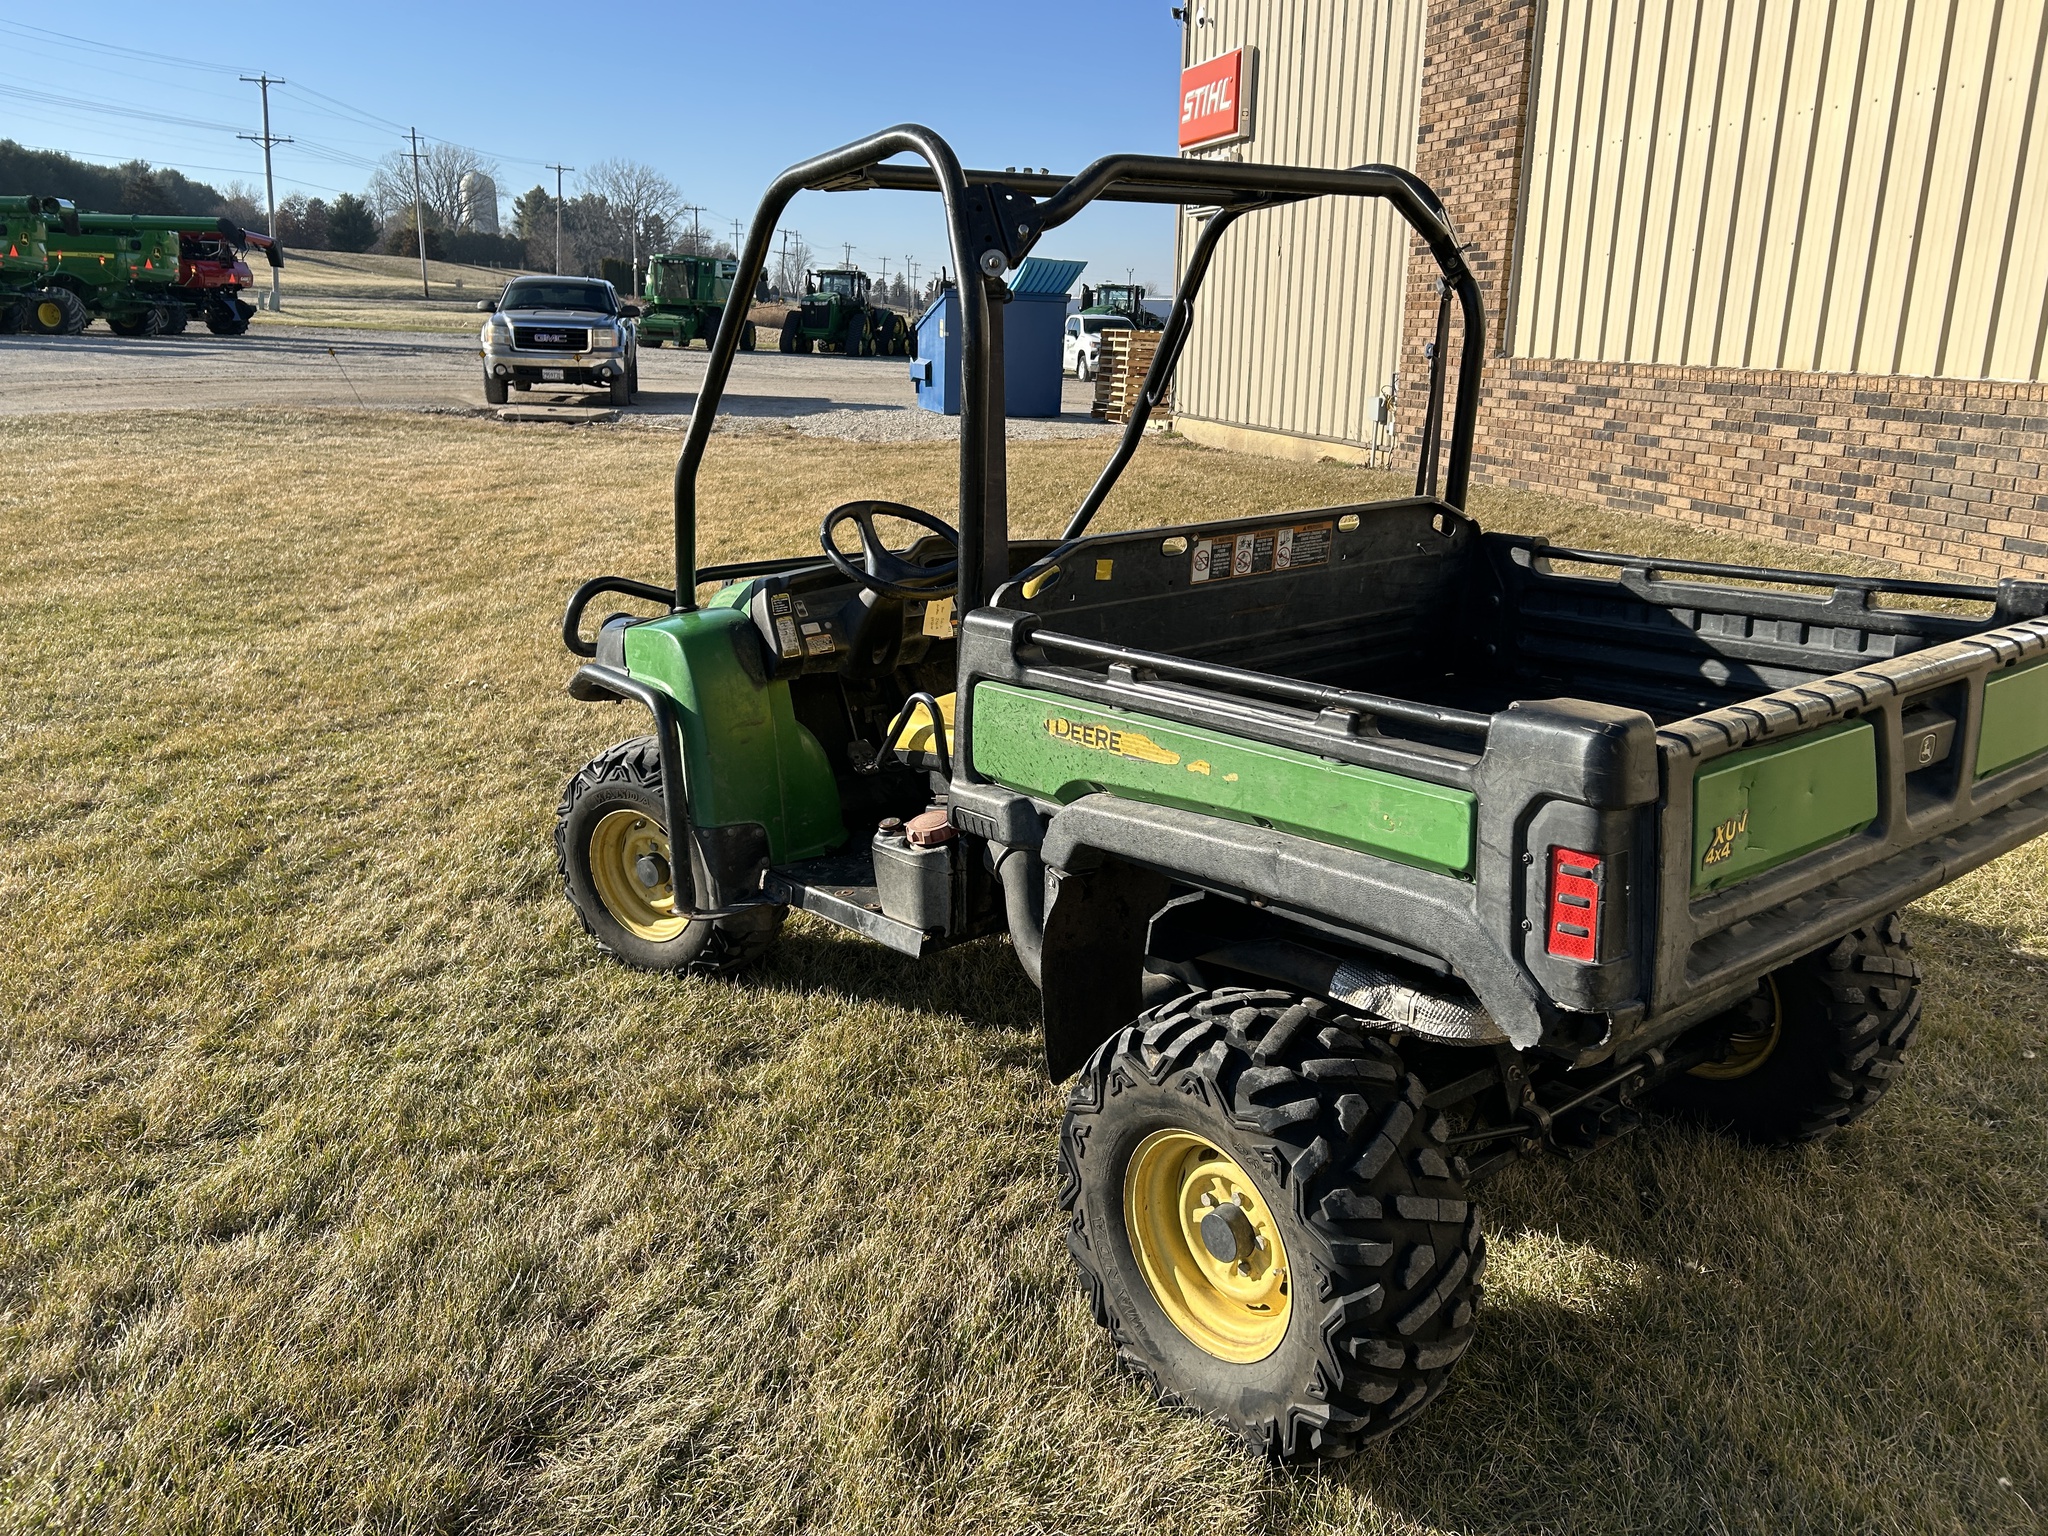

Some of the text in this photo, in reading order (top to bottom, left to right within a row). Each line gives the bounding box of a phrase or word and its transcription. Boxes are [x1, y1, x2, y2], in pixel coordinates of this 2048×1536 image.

[1181, 77, 1233, 124] STIHL
[534, 333, 567, 343] GMC
[1055, 718, 1122, 752] DEERE
[1713, 811, 1748, 847] XUV
[1705, 842, 1731, 864] 4x4
